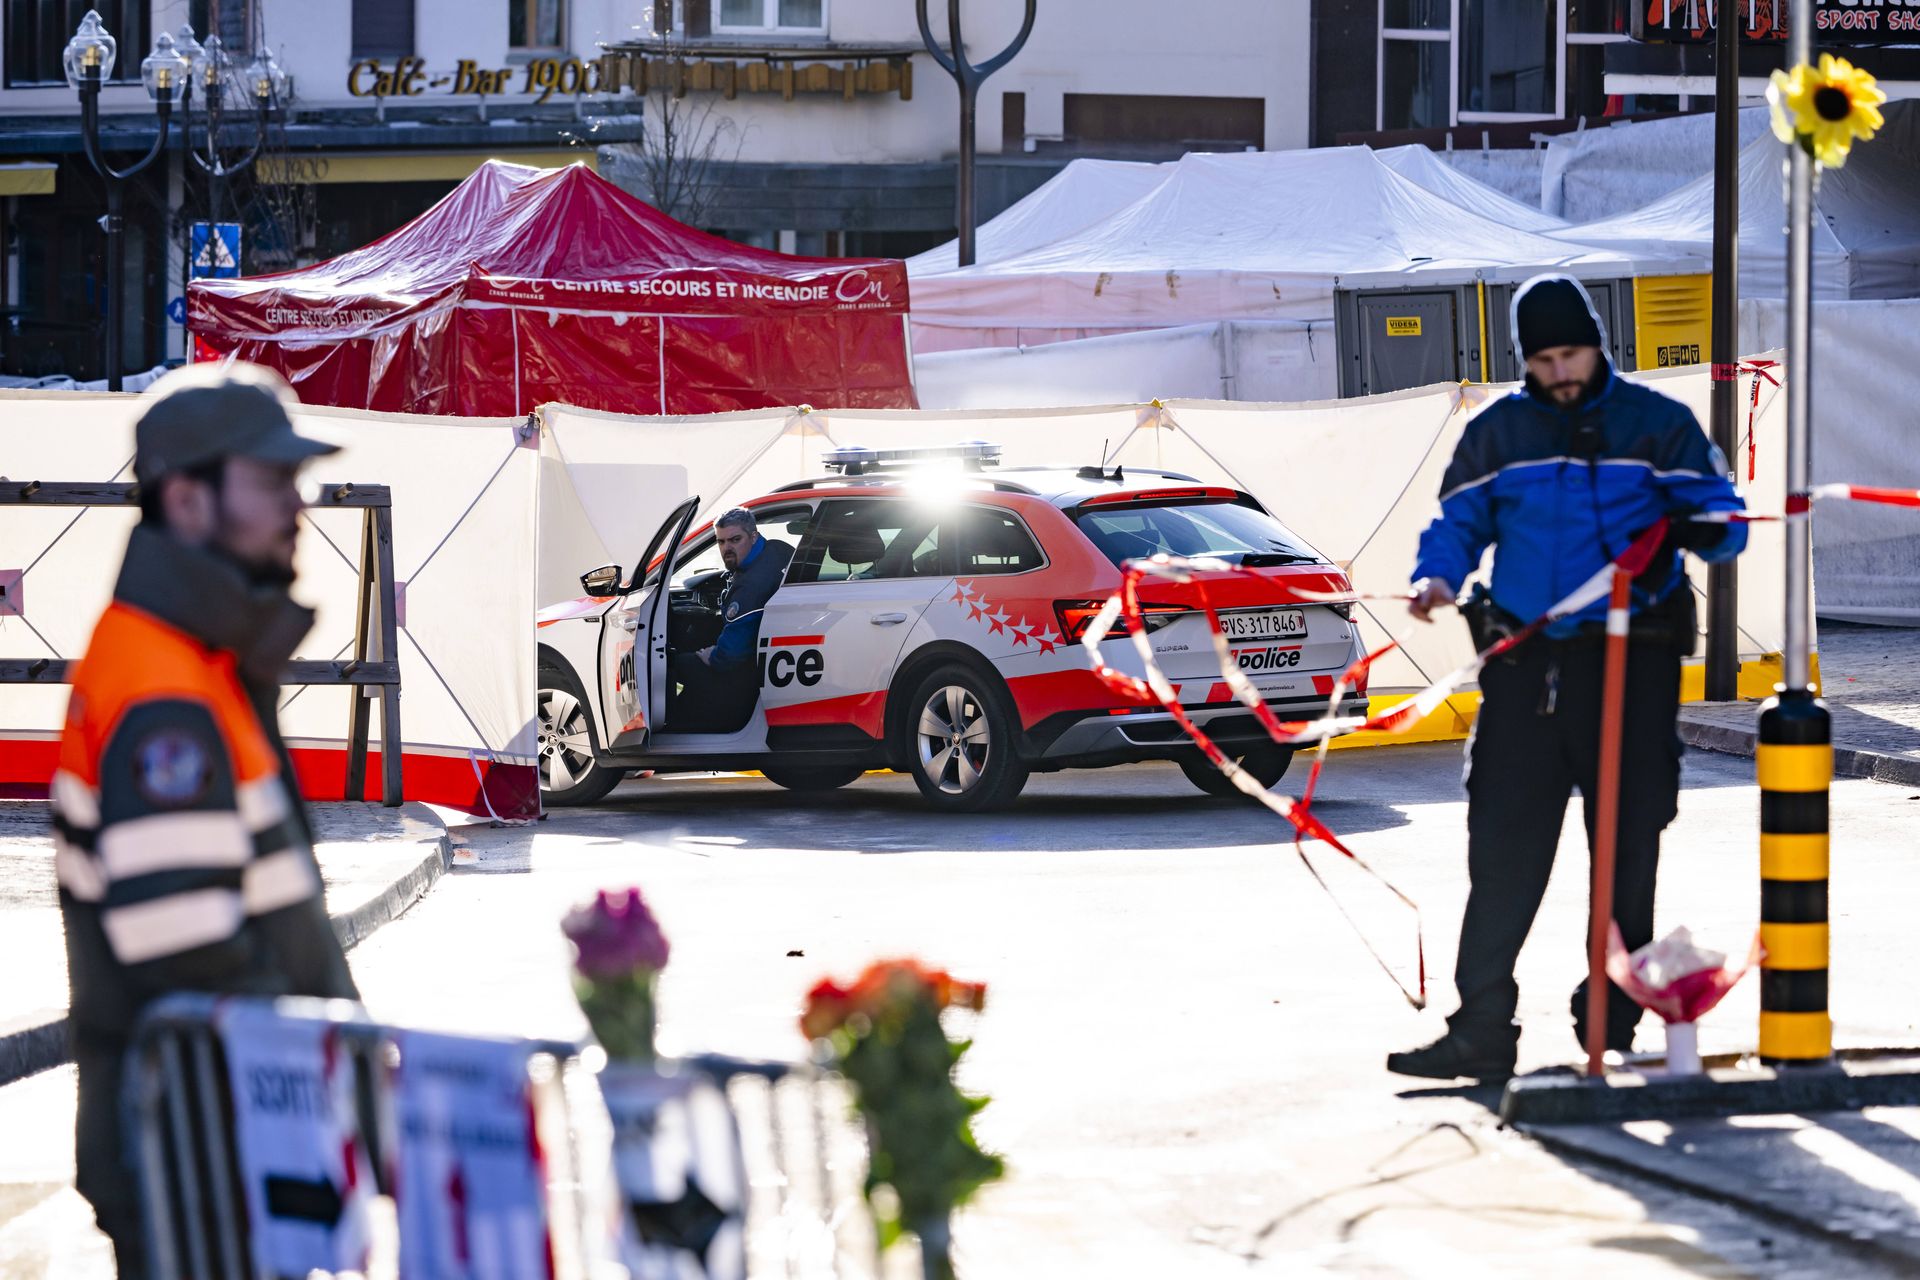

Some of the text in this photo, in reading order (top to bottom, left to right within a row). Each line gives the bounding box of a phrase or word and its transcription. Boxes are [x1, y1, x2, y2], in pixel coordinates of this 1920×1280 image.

[1815, 9, 1881, 30] SPORT
[522, 57, 602, 104] 1900
[629, 279, 711, 297] SECOURS
[716, 282, 738, 298] ET
[742, 283, 829, 301] INCENDIE
[265, 308, 299, 325] CENTRE
[340, 310, 349, 325] ET
[1238, 646, 1301, 670] police
